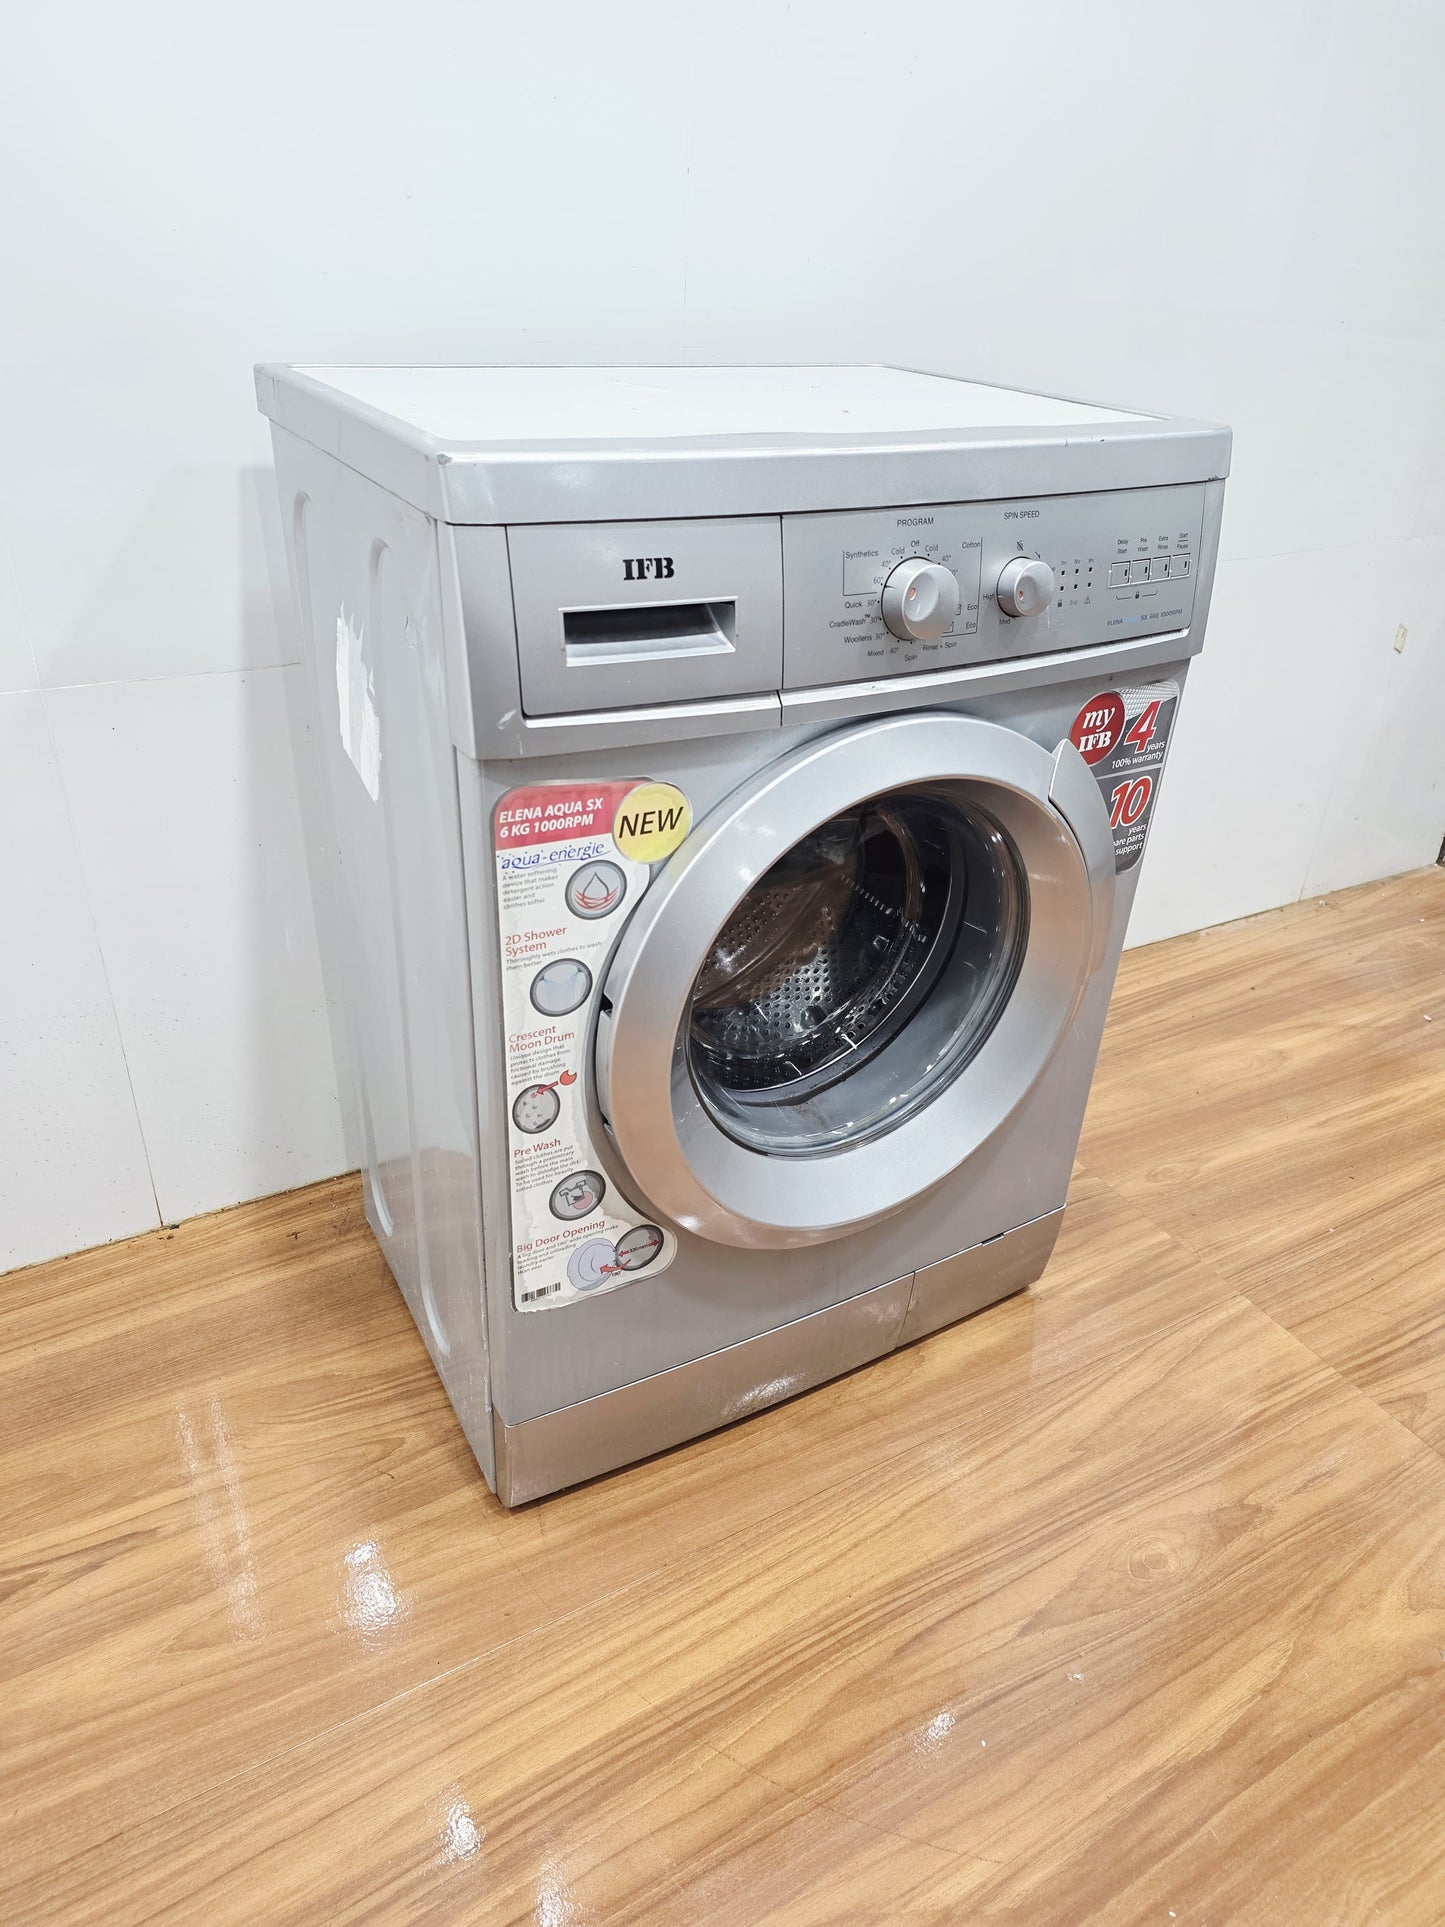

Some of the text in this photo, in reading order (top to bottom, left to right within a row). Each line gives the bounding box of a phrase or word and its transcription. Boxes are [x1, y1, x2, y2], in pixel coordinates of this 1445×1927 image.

[897, 517, 934, 527] PROGRAM
[1004, 510, 1040, 520] SPIN SPEED
[891, 547, 905, 556] Cold
[925, 544, 938, 552] Cold
[962, 541, 981, 550] Cotton
[845, 550, 878, 560] Synthetics
[622, 557, 674, 581] IFB
[844, 601, 862, 610] Quick
[844, 634, 872, 644] Woollens
[922, 644, 938, 652] Rinse
[904, 654, 918, 662] Spin
[1082, 707, 1116, 732] my
[1123, 699, 1162, 754] 4
[1078, 730, 1112, 753] IFB
[1146, 740, 1166, 754] years
[1112, 750, 1164, 769] 100% warranty
[1110, 776, 1153, 830] 10
[498, 797, 604, 824] ELENA AQUA SX
[500, 814, 594, 838] 6 KG 1000RPM
[618, 806, 684, 839] NEW
[1128, 823, 1147, 836] years
[1126, 834, 1144, 846] parts
[501, 842, 606, 870] aqua-energie
[1115, 842, 1144, 856] support
[528, 868, 558, 878] softening
[502, 881, 523, 889] device
[538, 875, 558, 883] makes
[502, 882, 555, 896] detergent action
[503, 895, 522, 903] easier
[504, 898, 545, 910] clothes softer
[505, 927, 568, 946] 2D Shower
[505, 942, 547, 958] System
[506, 953, 541, 965] Thoroughly
[557, 946, 579, 954] clothes
[524, 960, 542, 969] better
[509, 1026, 557, 1044] Crescent
[509, 1032, 576, 1054] Moon Drum
[510, 1052, 532, 1061] Unique
[532, 1047, 552, 1056] design
[510, 1058, 534, 1068] protects
[535, 1053, 556, 1062] clothes
[510, 1058, 561, 1074] frictional damage
[510, 1071, 532, 1080] caused
[540, 1062, 567, 1072] brushing
[511, 1076, 533, 1086] against
[544, 1070, 560, 1078] drum
[513, 1138, 561, 1158] Pre Wash
[515, 1161, 538, 1171] through
[543, 1150, 575, 1164] preliminary
[533, 1151, 553, 1160] clothes
[530, 1164, 548, 1172] before
[554, 1167, 574, 1176] heavily
[533, 1179, 553, 1188] clothes
[516, 1220, 606, 1254] Big Door Opening
[533, 1247, 546, 1255] door
[582, 1229, 604, 1240] opening
[550, 1243, 577, 1256] unloading
